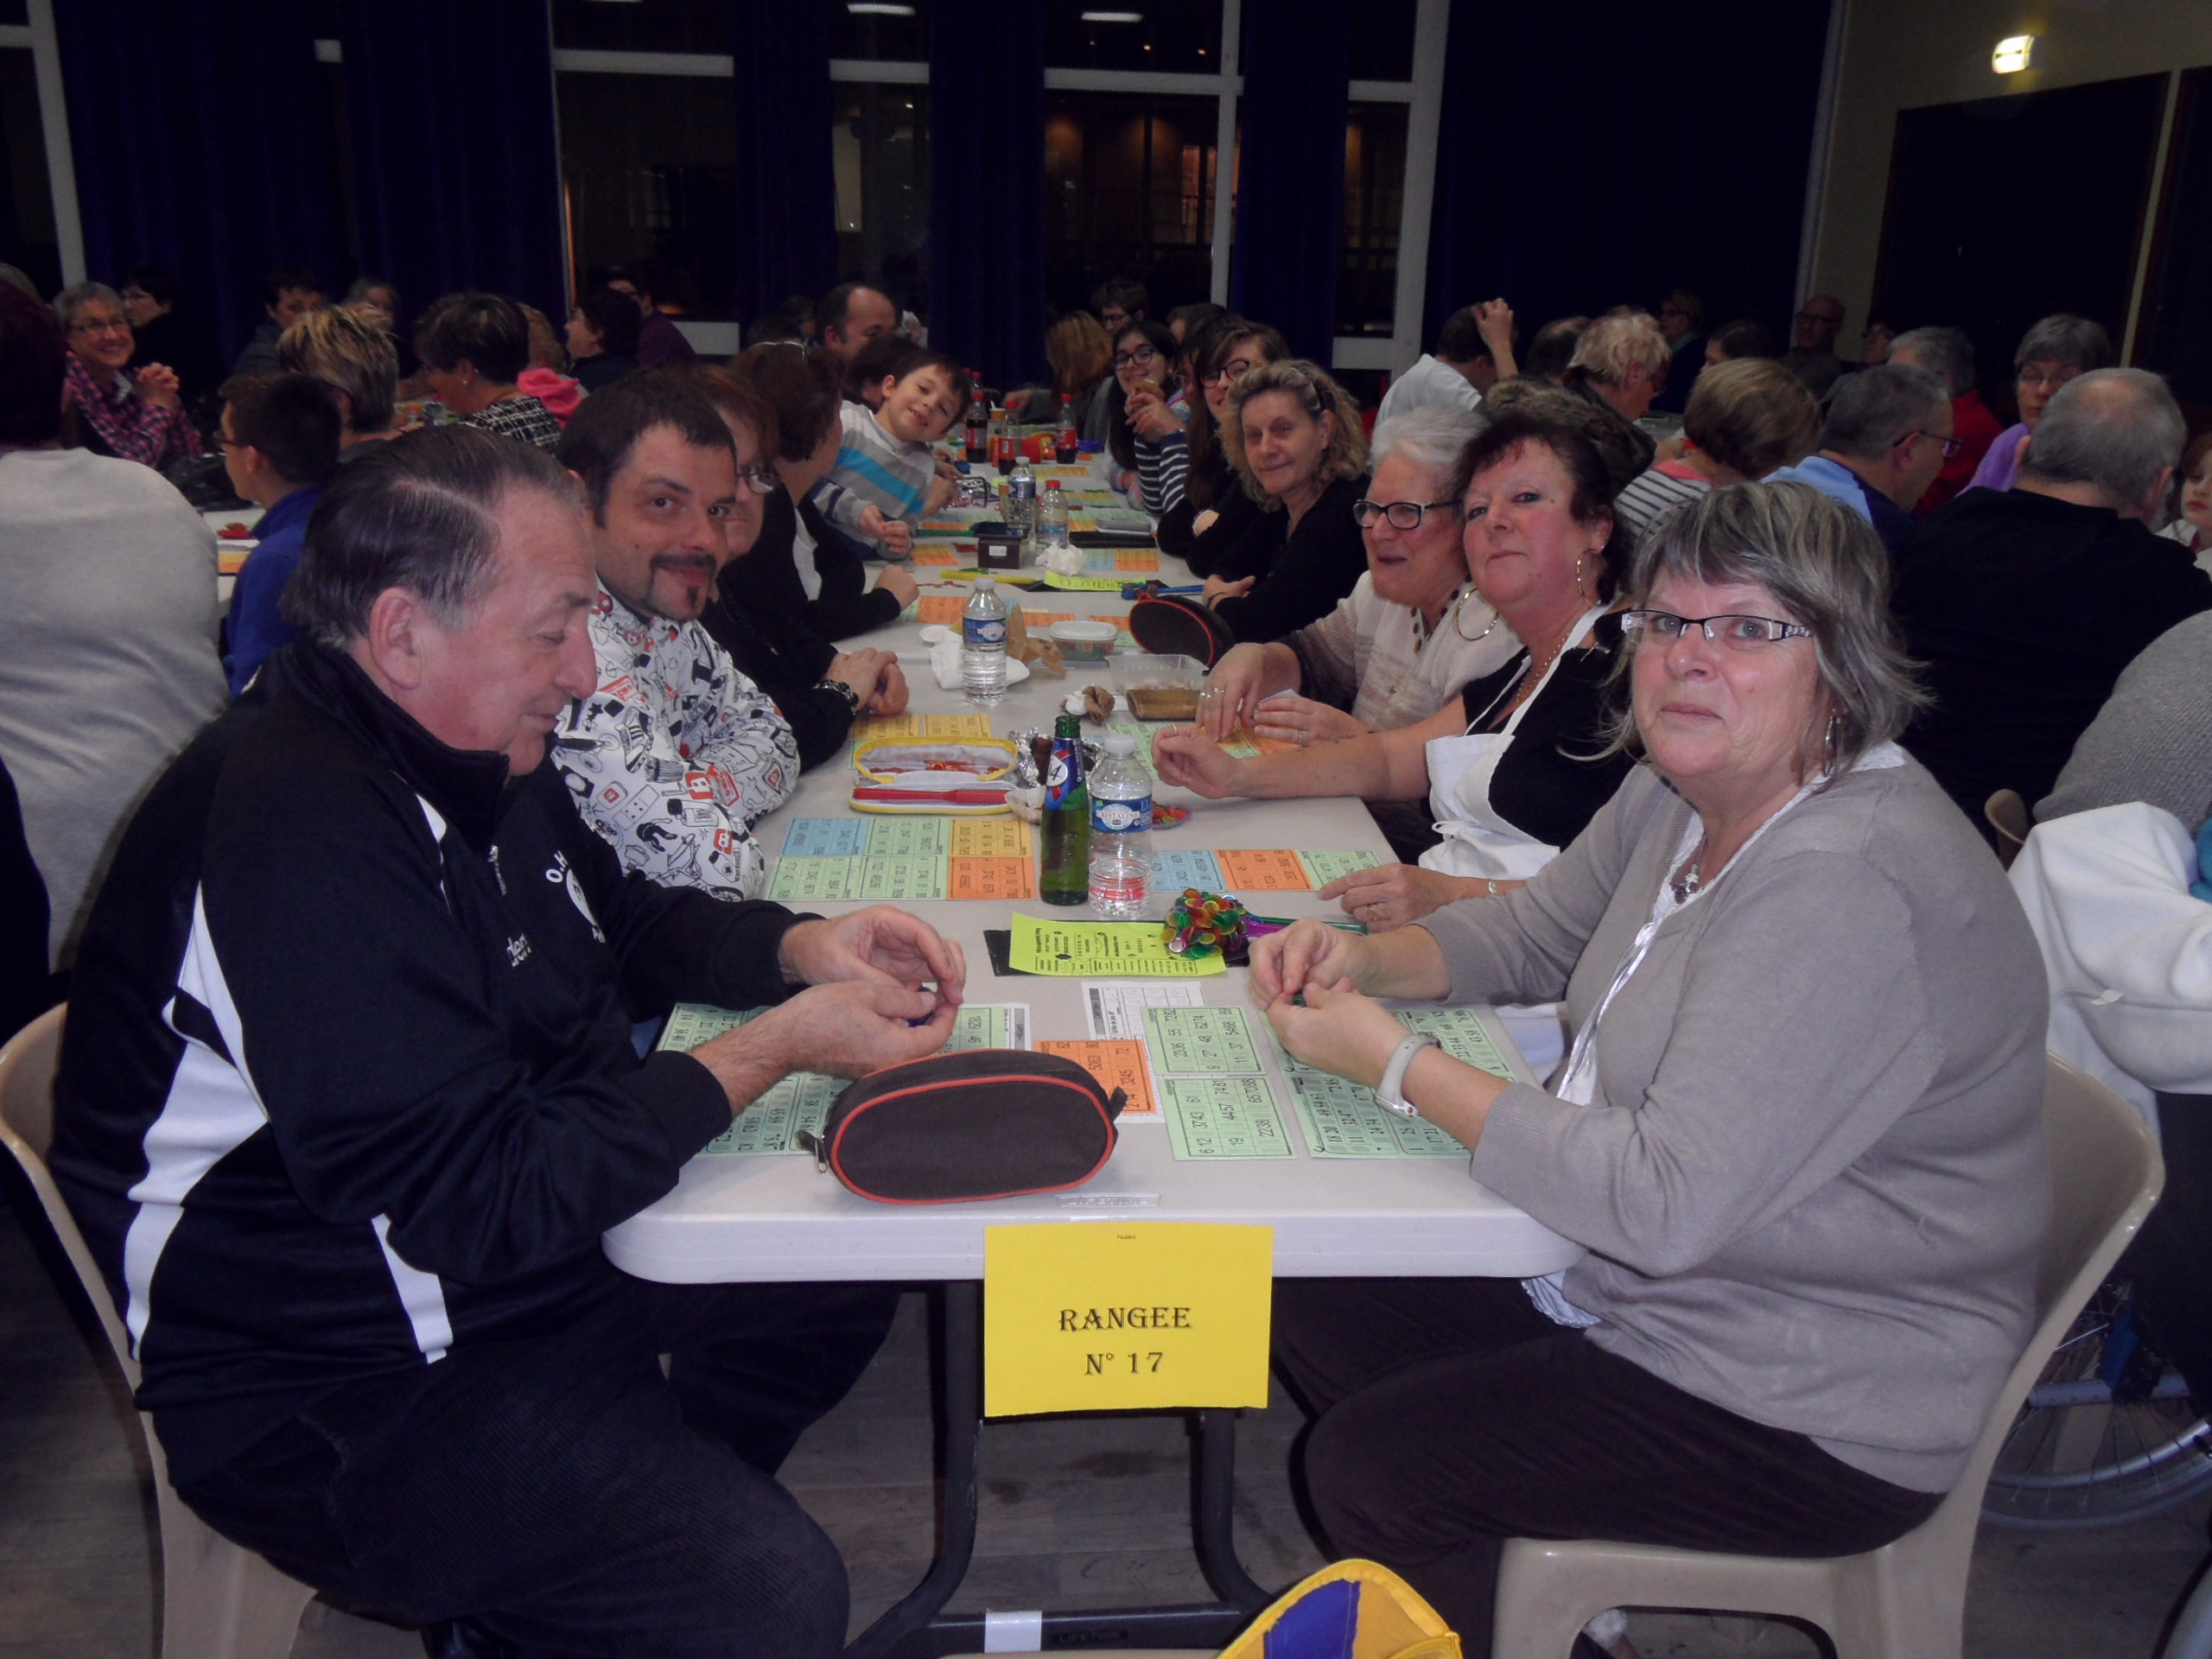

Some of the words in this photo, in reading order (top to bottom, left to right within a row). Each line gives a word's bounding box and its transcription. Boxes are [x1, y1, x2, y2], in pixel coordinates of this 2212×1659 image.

[1255, 1120, 1269, 1128] 38
[1059, 1307, 1192, 1332] RANGEE
[1085, 1352, 1115, 1376] N°
[1127, 1351, 1164, 1374] 17
